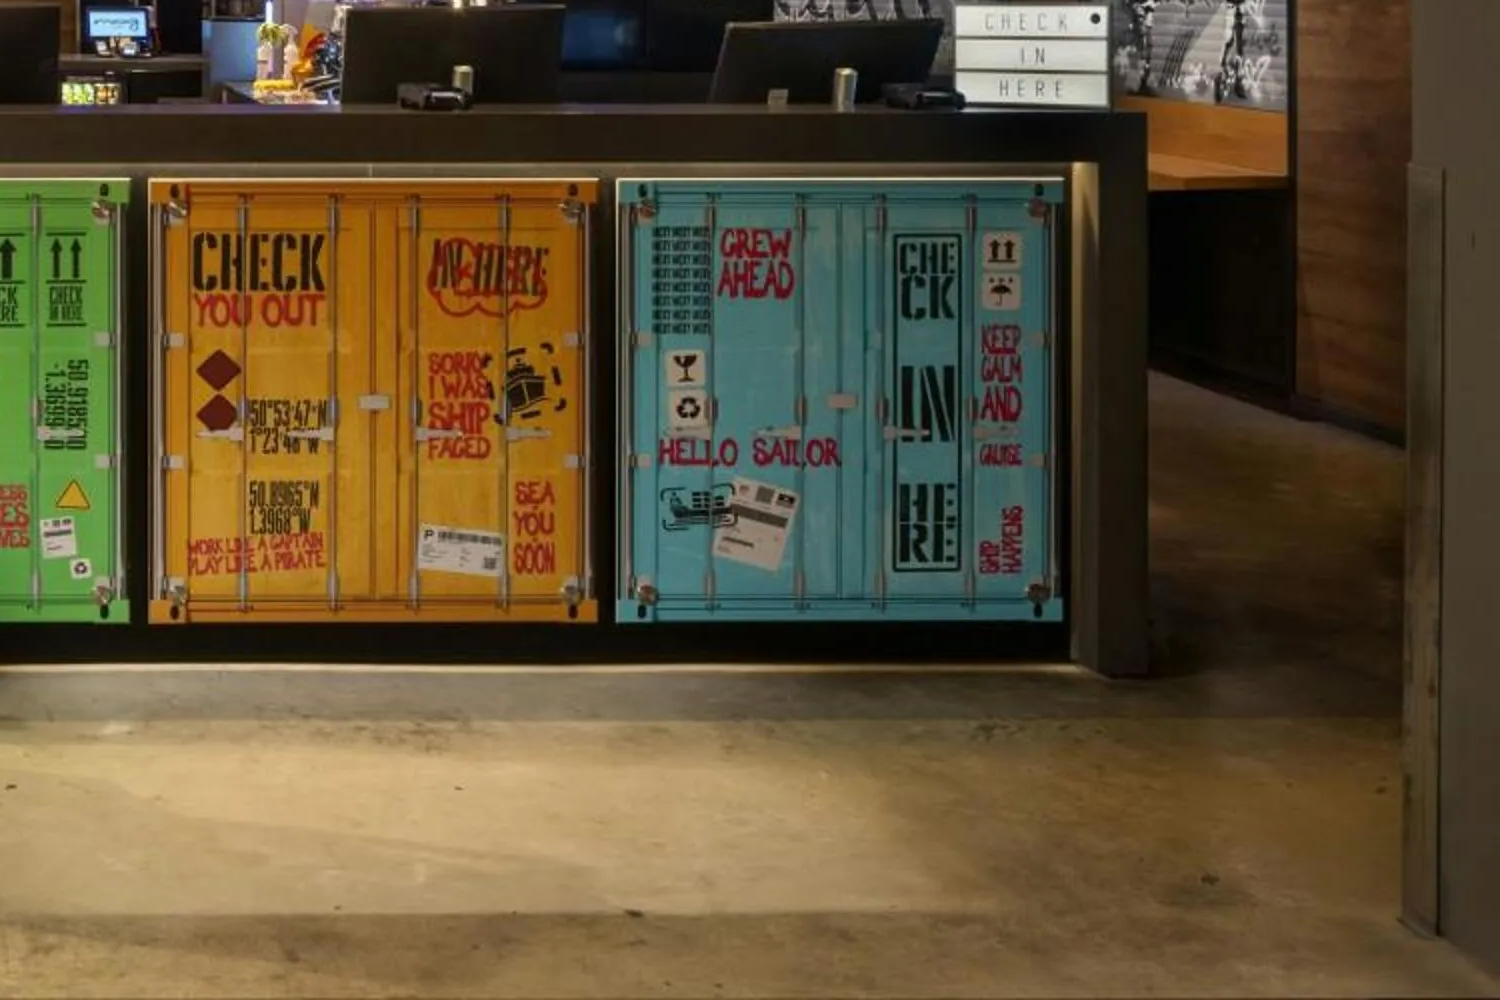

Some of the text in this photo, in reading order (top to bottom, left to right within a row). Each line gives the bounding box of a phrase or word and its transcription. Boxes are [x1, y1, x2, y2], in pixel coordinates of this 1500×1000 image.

[984, 12, 1068, 31] CHECK
[1020, 47, 1046, 65] IN
[998, 79, 1066, 99] HERE
[194, 231, 326, 292] CHECK
[899, 242, 956, 275] CHE
[717, 260, 795, 300] AHEAD
[194, 292, 326, 329] YOU OUT
[900, 275, 956, 320] CK
[981, 325, 1022, 355] KEEP
[428, 351, 486, 375] SORRY
[428, 375, 488, 400] I WAS
[900, 365, 956, 442] IN
[980, 384, 1022, 422] AND
[44, 362, 66, 450] -1.36990
[428, 401, 490, 435] SHIP
[658, 437, 843, 468] HELLO SAILOR
[515, 480, 556, 505] SEA
[899, 483, 956, 522] HE
[513, 511, 555, 536] YOU
[513, 541, 556, 575] SOON
[899, 523, 956, 563] RE
